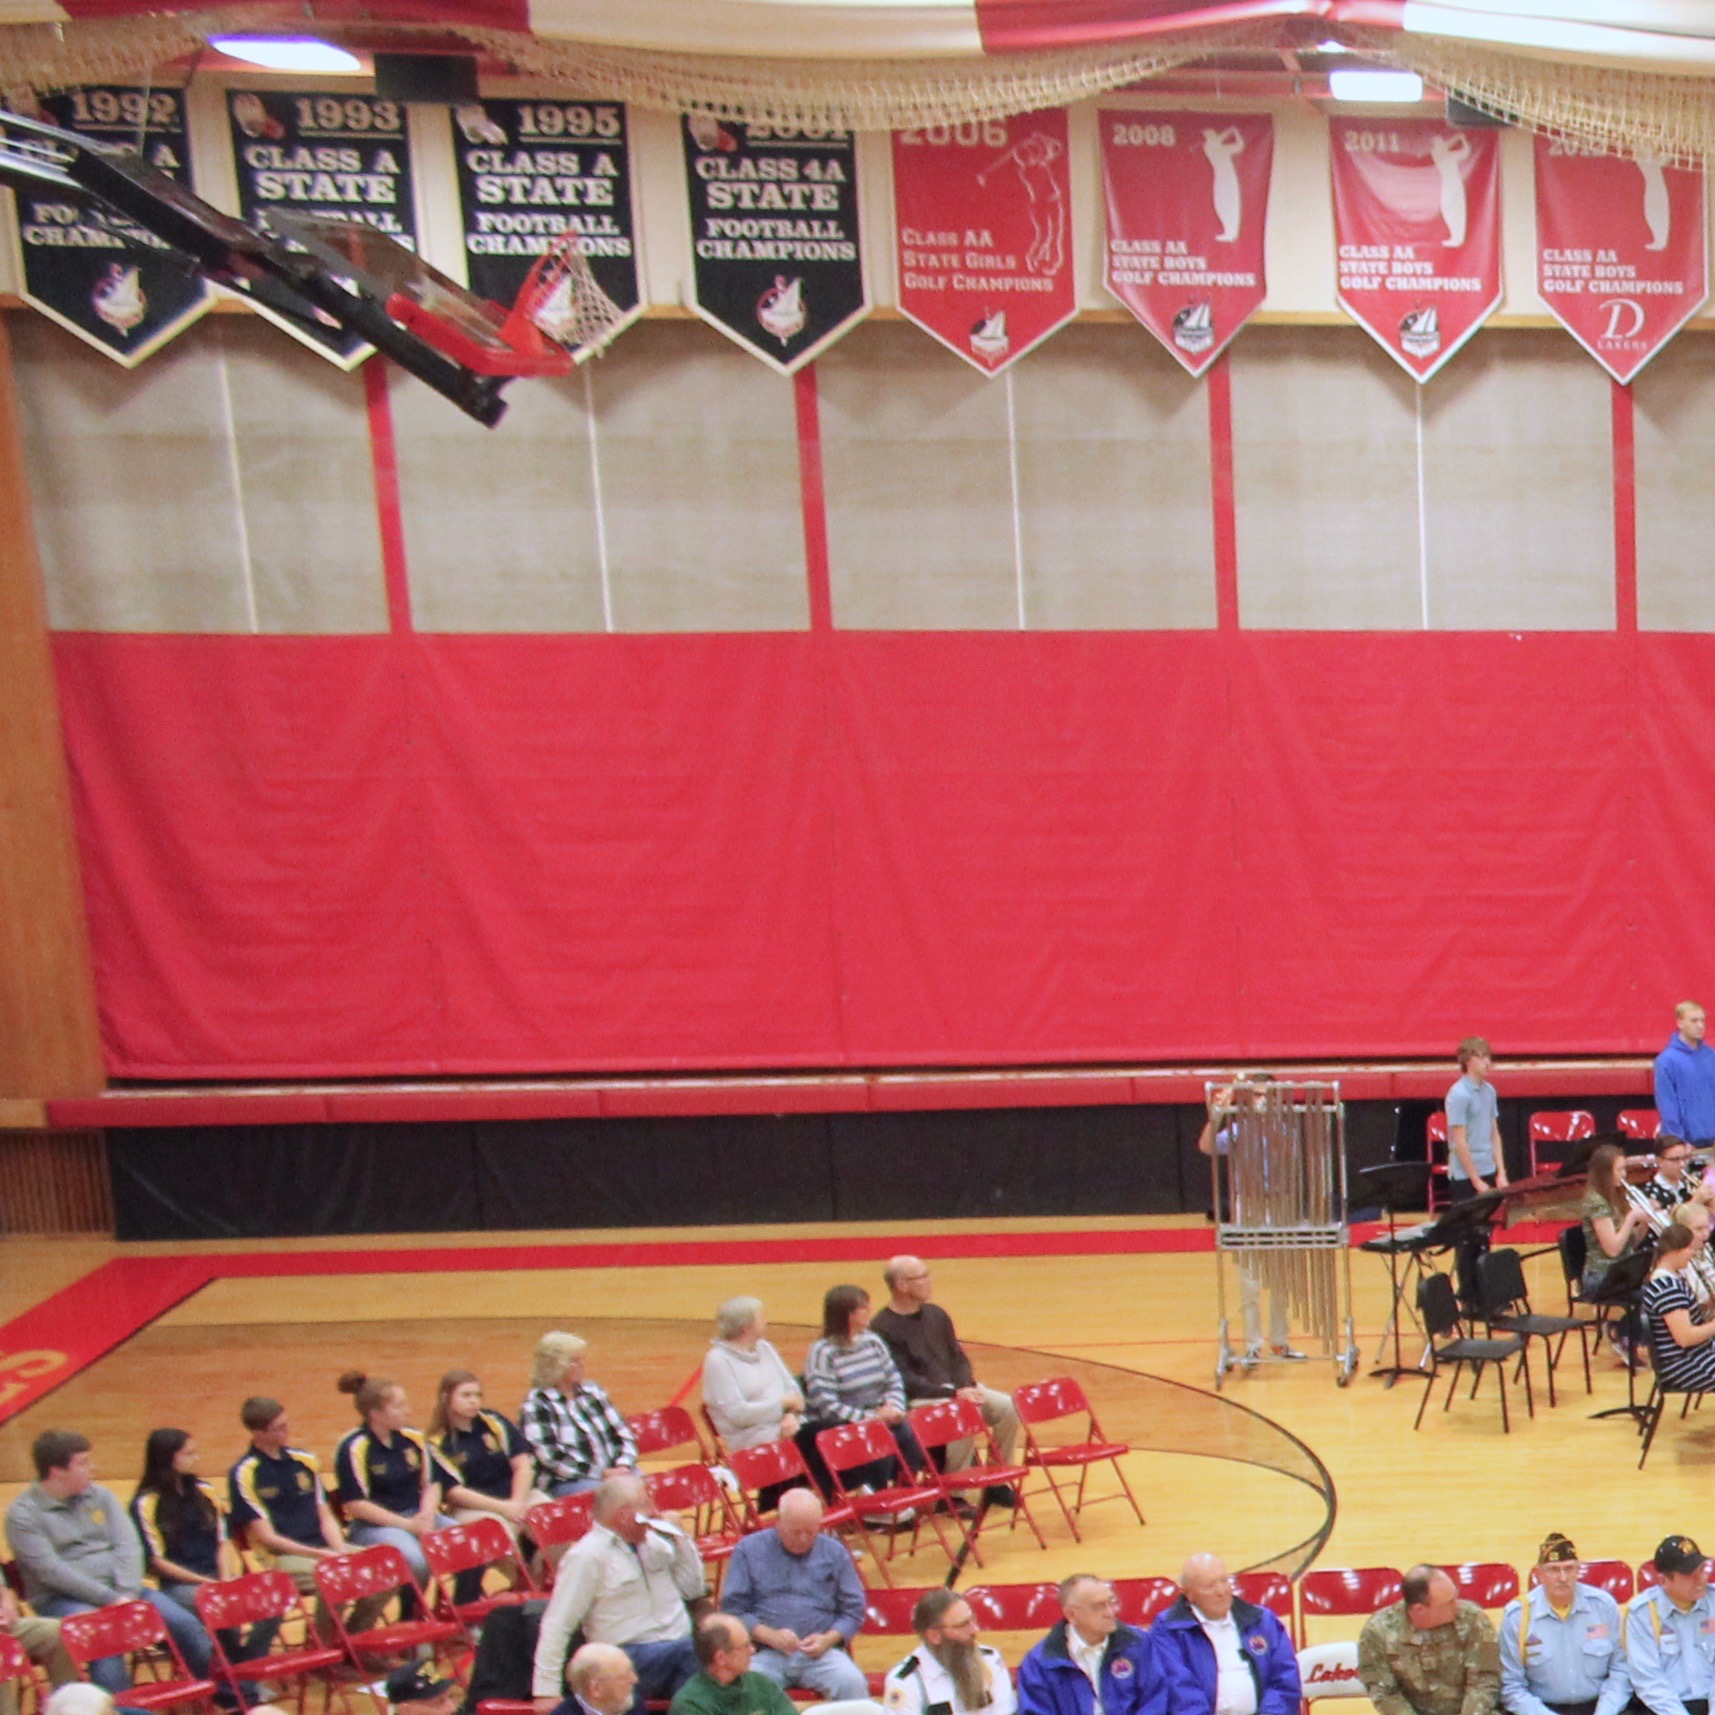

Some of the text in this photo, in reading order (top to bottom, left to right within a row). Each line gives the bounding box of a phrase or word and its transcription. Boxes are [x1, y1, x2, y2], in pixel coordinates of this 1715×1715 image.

[518, 105, 621, 137] 1995
[1112, 123, 1177, 147] 2008
[244, 146, 401, 174] CLASS A
[466, 150, 619, 177] CLASS A
[695, 157, 847, 183] CLASS 4A
[255, 171, 396, 204] STATE
[476, 175, 614, 207] STATE
[706, 181, 839, 211] STATE
[475, 211, 621, 236] FOOTBALL
[705, 218, 845, 240] FOOTBALL
[964, 229, 994, 248] AA
[1110, 240, 1189, 255] CLASS AA
[697, 239, 857, 262] CHAMPIONS
[1339, 245, 1416, 260] CLASS AA
[1543, 249, 1618, 263] CLASS AA
[1111, 255, 1207, 271] STATE BOYS
[1340, 260, 1434, 276] STATE BOYS
[1543, 264, 1636, 279] STATE BOYS
[1111, 270, 1256, 287] GOLF CHAMPIONS
[1339, 276, 1482, 292] GOLF CHAMPIONS
[1543, 280, 1684, 295] GOLF CHAMPIONS
[1599, 298, 1645, 339] D
[1304, 1662, 1360, 1684] Lake
